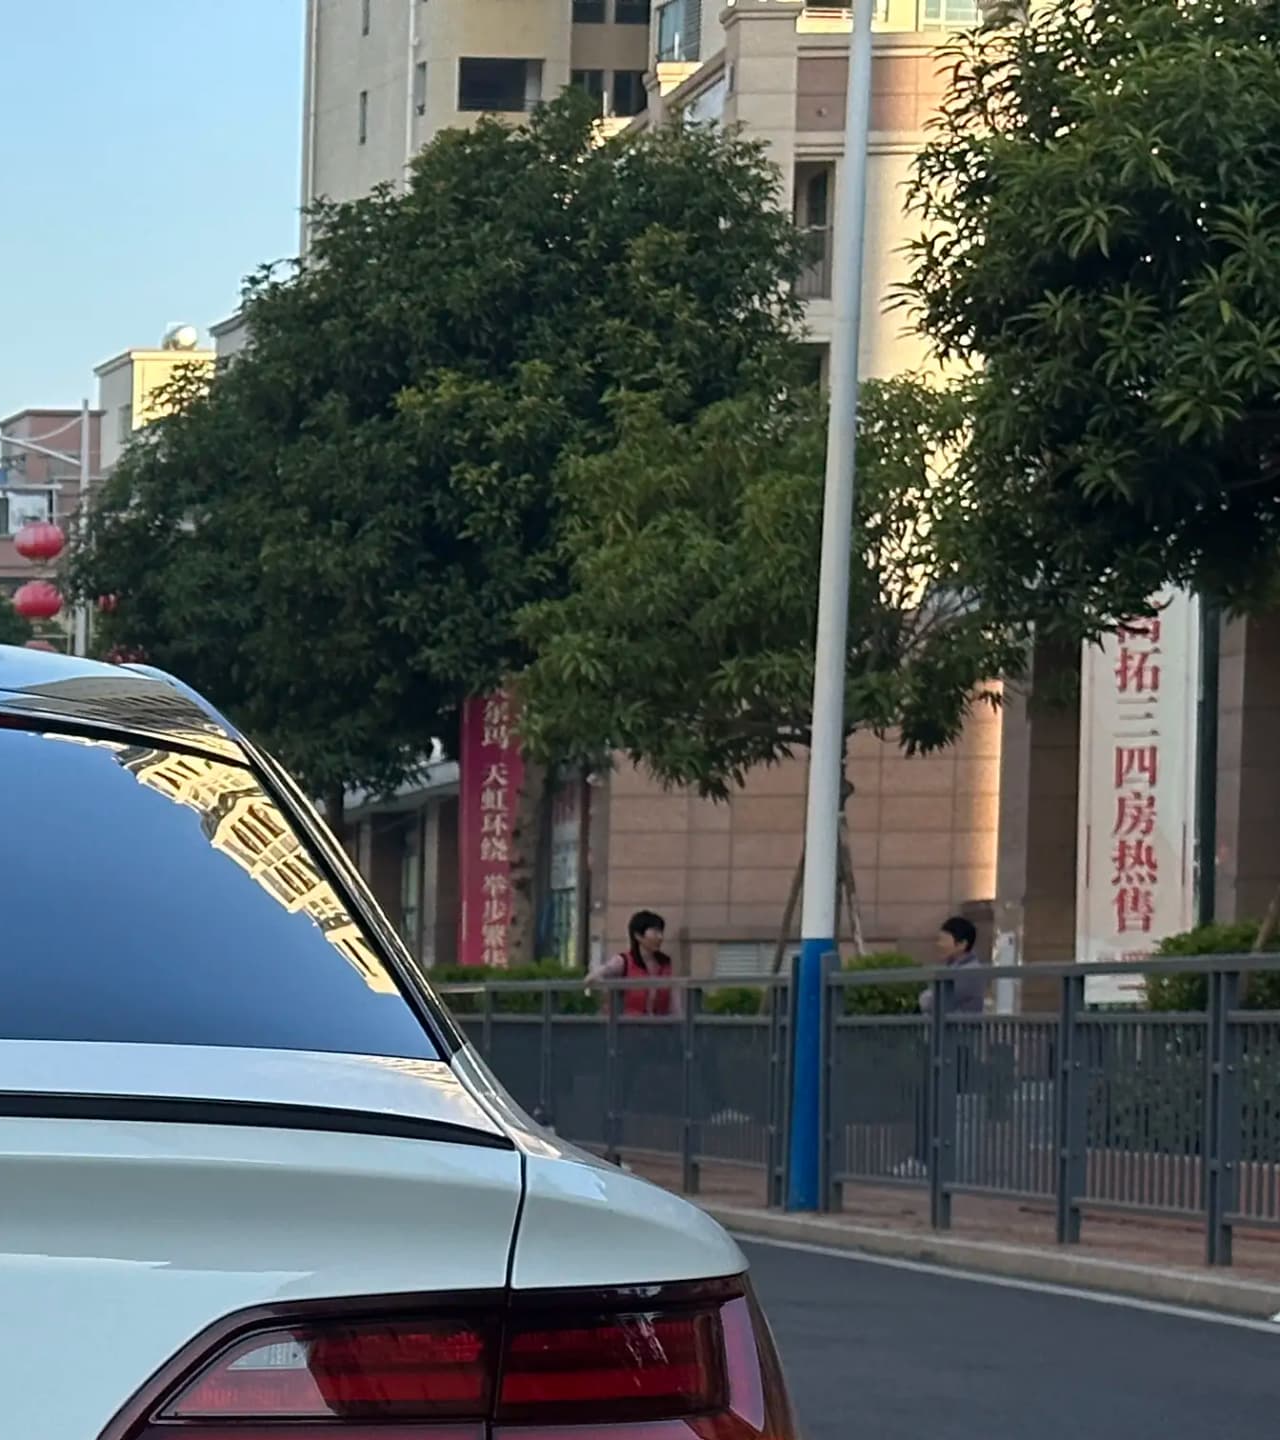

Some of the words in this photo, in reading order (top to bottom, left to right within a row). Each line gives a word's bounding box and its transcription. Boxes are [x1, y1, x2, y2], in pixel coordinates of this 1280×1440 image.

[481, 686, 510, 750] 尔玛
[481, 762, 509, 861] 天虹环绕
